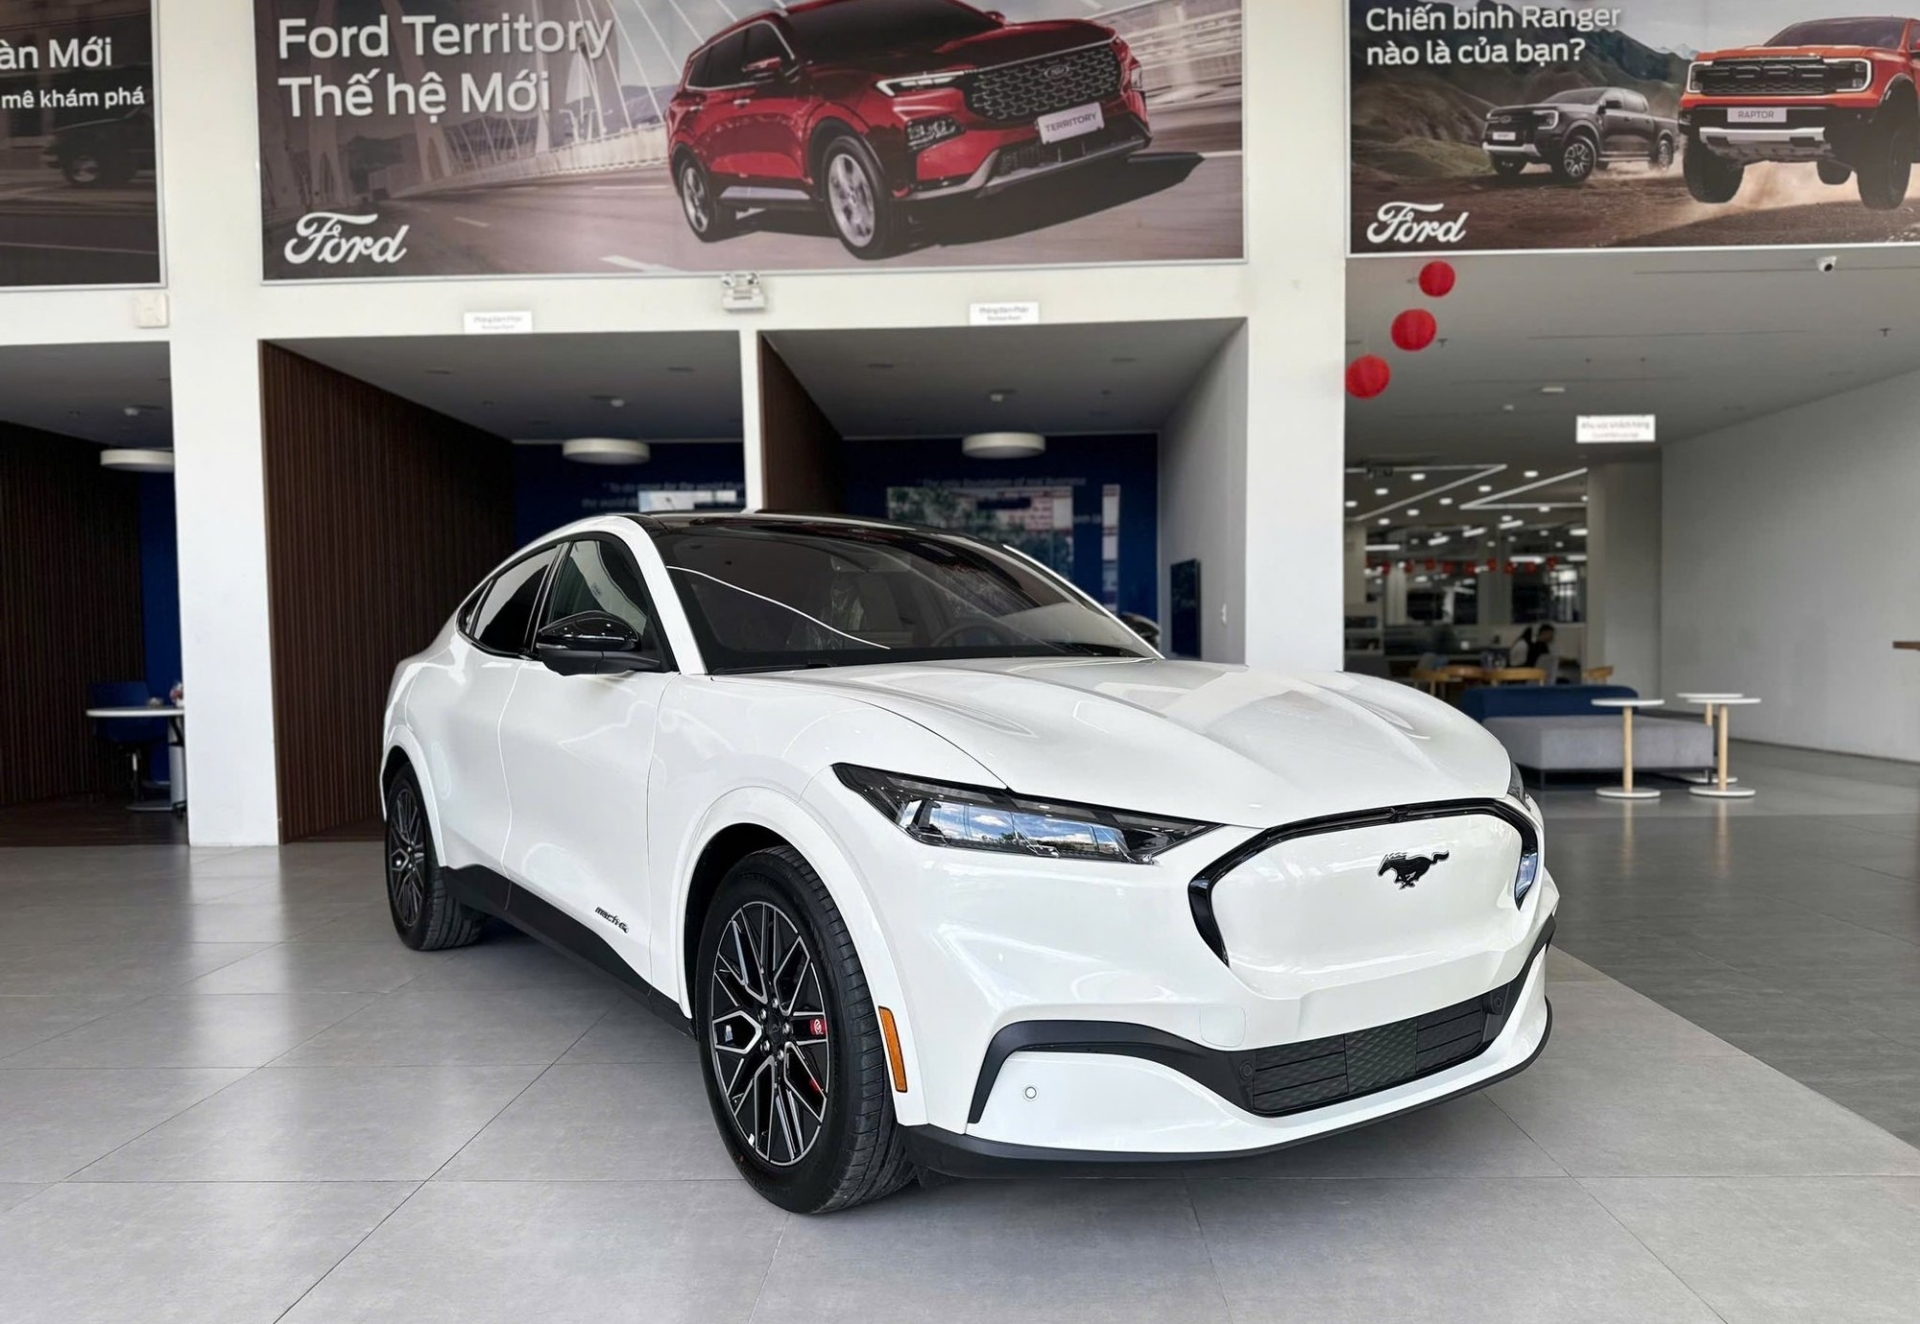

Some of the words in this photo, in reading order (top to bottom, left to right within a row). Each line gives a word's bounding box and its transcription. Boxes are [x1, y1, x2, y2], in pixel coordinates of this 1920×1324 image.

[1366, 2, 1446, 32] Chiến
[1453, 5, 1514, 31] binh
[1521, 5, 1622, 32] Ranger
[278, 14, 389, 60] Ford
[401, 12, 614, 60] Territory
[1366, 40, 1420, 66] nào
[1426, 39, 1452, 65] là
[1457, 36, 1509, 64] của
[1515, 38, 1586, 67] bạn?
[49, 36, 112, 68] Mới
[1, 90, 35, 109] mê
[40, 88, 99, 108] khám
[104, 85, 145, 110] phá
[277, 68, 381, 117] Thế
[387, 71, 447, 123] hệ
[461, 69, 550, 114] Mới
[1044, 111, 1097, 133] TERRITORY
[1737, 110, 1775, 119] RAPTOR
[284, 211, 410, 264] Ford
[1366, 201, 1470, 244] Ford
